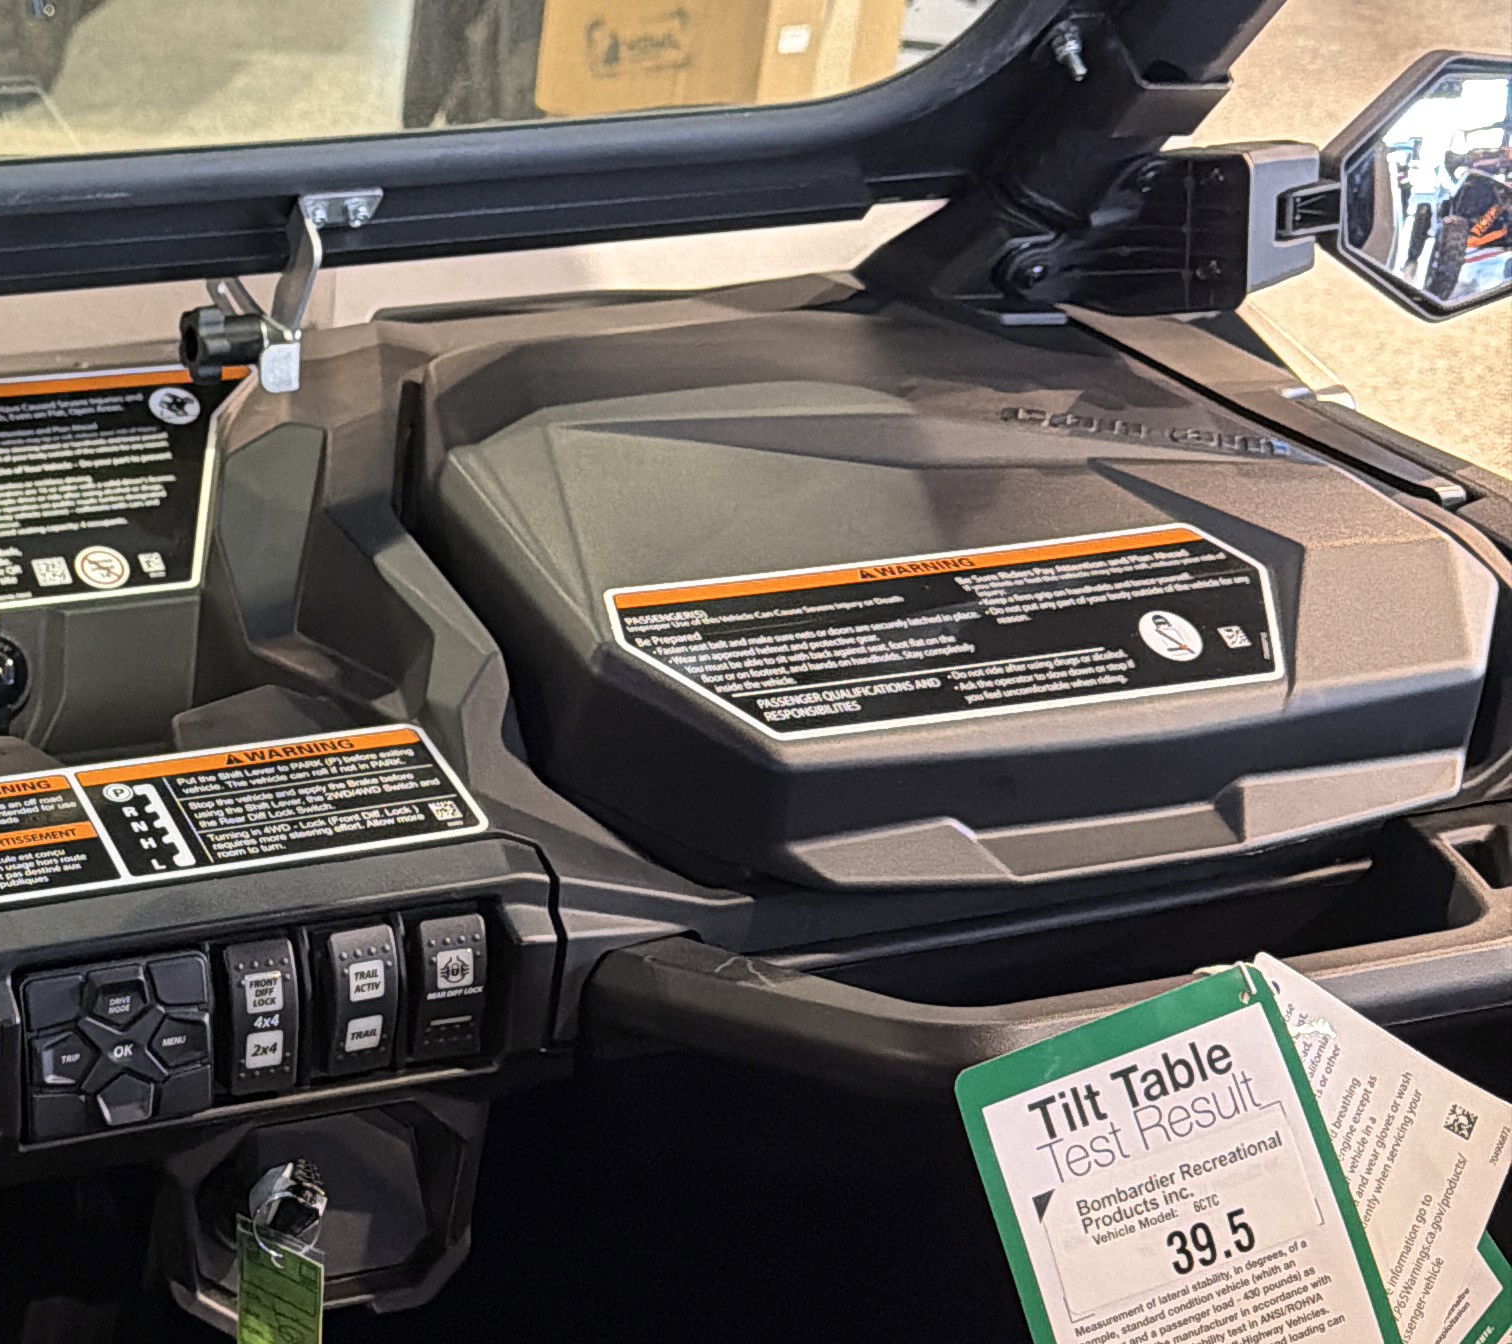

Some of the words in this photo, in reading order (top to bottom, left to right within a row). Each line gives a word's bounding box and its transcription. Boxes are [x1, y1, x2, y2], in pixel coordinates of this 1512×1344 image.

[873, 558, 976, 576] WARNING
[756, 691, 822, 709] PASSENGER
[821, 680, 914, 701] QUALIFICATIONS
[914, 677, 941, 689] AND
[244, 738, 354, 761] WARNING
[23, 797, 37, 806] off
[38, 794, 63, 805] road
[112, 788, 124, 797] P
[40, 803, 54, 811] for
[56, 801, 77, 809] use
[121, 806, 139, 817] R
[130, 821, 148, 832] N
[140, 837, 157, 849] H
[151, 858, 166, 870] L
[354, 968, 380, 981] TRAIL
[249, 977, 279, 989] FRONT
[354, 981, 381, 994] ACTIV
[255, 988, 275, 998] DIFF
[446, 988, 463, 998] DIFF
[463, 985, 484, 996] LOCK
[109, 995, 131, 1006] DRIVE
[253, 997, 277, 1008] LOCK
[108, 1004, 131, 1014] MODE
[253, 1013, 280, 1029] 4x4
[162, 1035, 187, 1047] MENU
[351, 1028, 378, 1041] TRAIL
[113, 1043, 134, 1058] OK
[252, 1042, 278, 1057] 2x4
[61, 1053, 81, 1064] TRIP
[1027, 1083, 1108, 1139] Tilt
[1109, 1041, 1232, 1108] Table
[1035, 1121, 1130, 1183] Test
[1132, 1070, 1261, 1150] Result
[1356, 1174, 1369, 1198] and
[1363, 1147, 1380, 1175] wear
[1375, 1112, 1395, 1149] gloves
[1390, 1099, 1400, 1113] or
[1395, 1071, 1412, 1099] wash
[1373, 1163, 1391, 1193] when
[1386, 1115, 1413, 1163] servicing
[1405, 1088, 1422, 1116] your
[1075, 1171, 1175, 1218] Bombardier
[1178, 1130, 1282, 1180] Recreational
[1420, 1194, 1432, 1207] to
[1081, 1197, 1159, 1234] Products
[1161, 1187, 1194, 1205] inc.
[1415, 1207, 1426, 1224] go
[1091, 1223, 1135, 1245] Vehicle
[1137, 1207, 1178, 1230] Model:
[1193, 1193, 1219, 1212] 6CTC
[1166, 1208, 1256, 1276] 39.5
[1388, 1224, 1420, 1287] information
[1074, 1303, 1144, 1337] Measurement
[1145, 1297, 1156, 1310] of
[1157, 1284, 1190, 1305] lateral
[1191, 1270, 1232, 1292] stability,
[1232, 1265, 1243, 1275] in
[1244, 1249, 1287, 1270] degrees,
[1288, 1240, 1298, 1253] of
[1300, 1240, 1307, 1248] a
[1120, 1309, 1166, 1334] standard
[1167, 1292, 1214, 1316] condition
[1214, 1278, 1250, 1297] vehicle
[1282, 1259, 1296, 1270] an
[1150, 1329, 1157, 1338] a
[1158, 1308, 1210, 1336] passenger
[1211, 1296, 1234, 1313] load
[1242, 1286, 1260, 1300] 430
[1261, 1270, 1302, 1296] pounds)
[1303, 1266, 1315, 1277] as
[1172, 1312, 1238, 1344] manufacturer
[1239, 1307, 1250, 1317] in
[1251, 1284, 1308, 1313] accordance
[1309, 1274, 1332, 1289] with
[1226, 1322, 1247, 1337] test
[1247, 1319, 1258, 1329] in
[1260, 1292, 1323, 1325] ANSI/ROHVA
[1284, 1307, 1329, 1328] Vehicles.
[1287, 1322, 1325, 1342] loading
[1326, 1314, 1345, 1327] can
